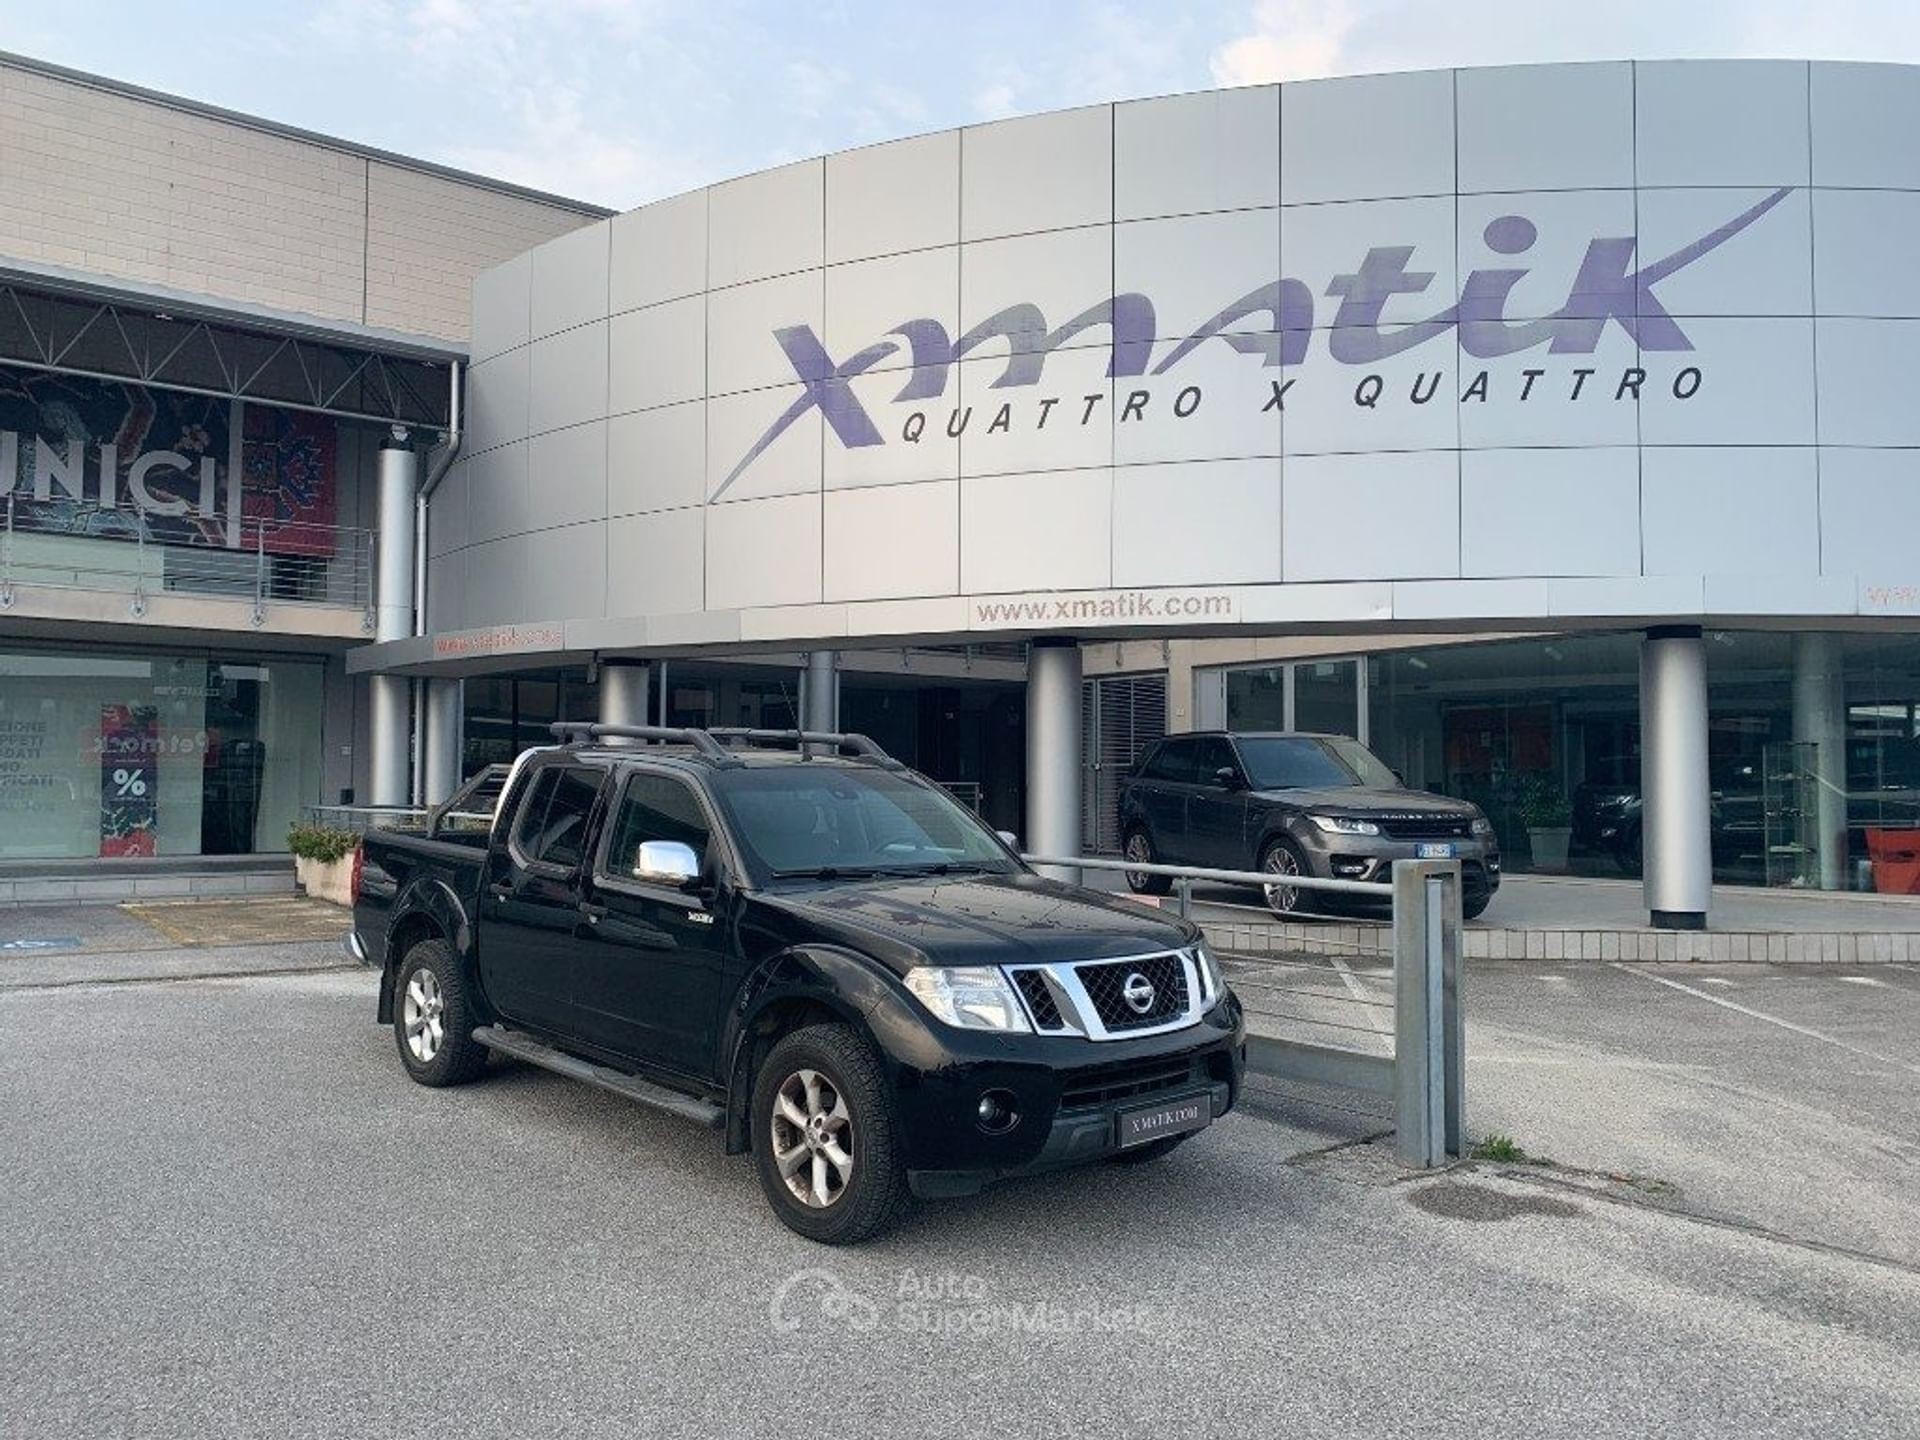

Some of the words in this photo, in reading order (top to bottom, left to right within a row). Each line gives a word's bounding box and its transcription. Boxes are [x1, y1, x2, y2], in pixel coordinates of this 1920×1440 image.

[902, 385, 1202, 443] QUATTRO
[1262, 379, 1296, 412] X
[1354, 367, 1703, 408] QUATTRO
[977, 592, 1232, 622] www.xmatik.com
